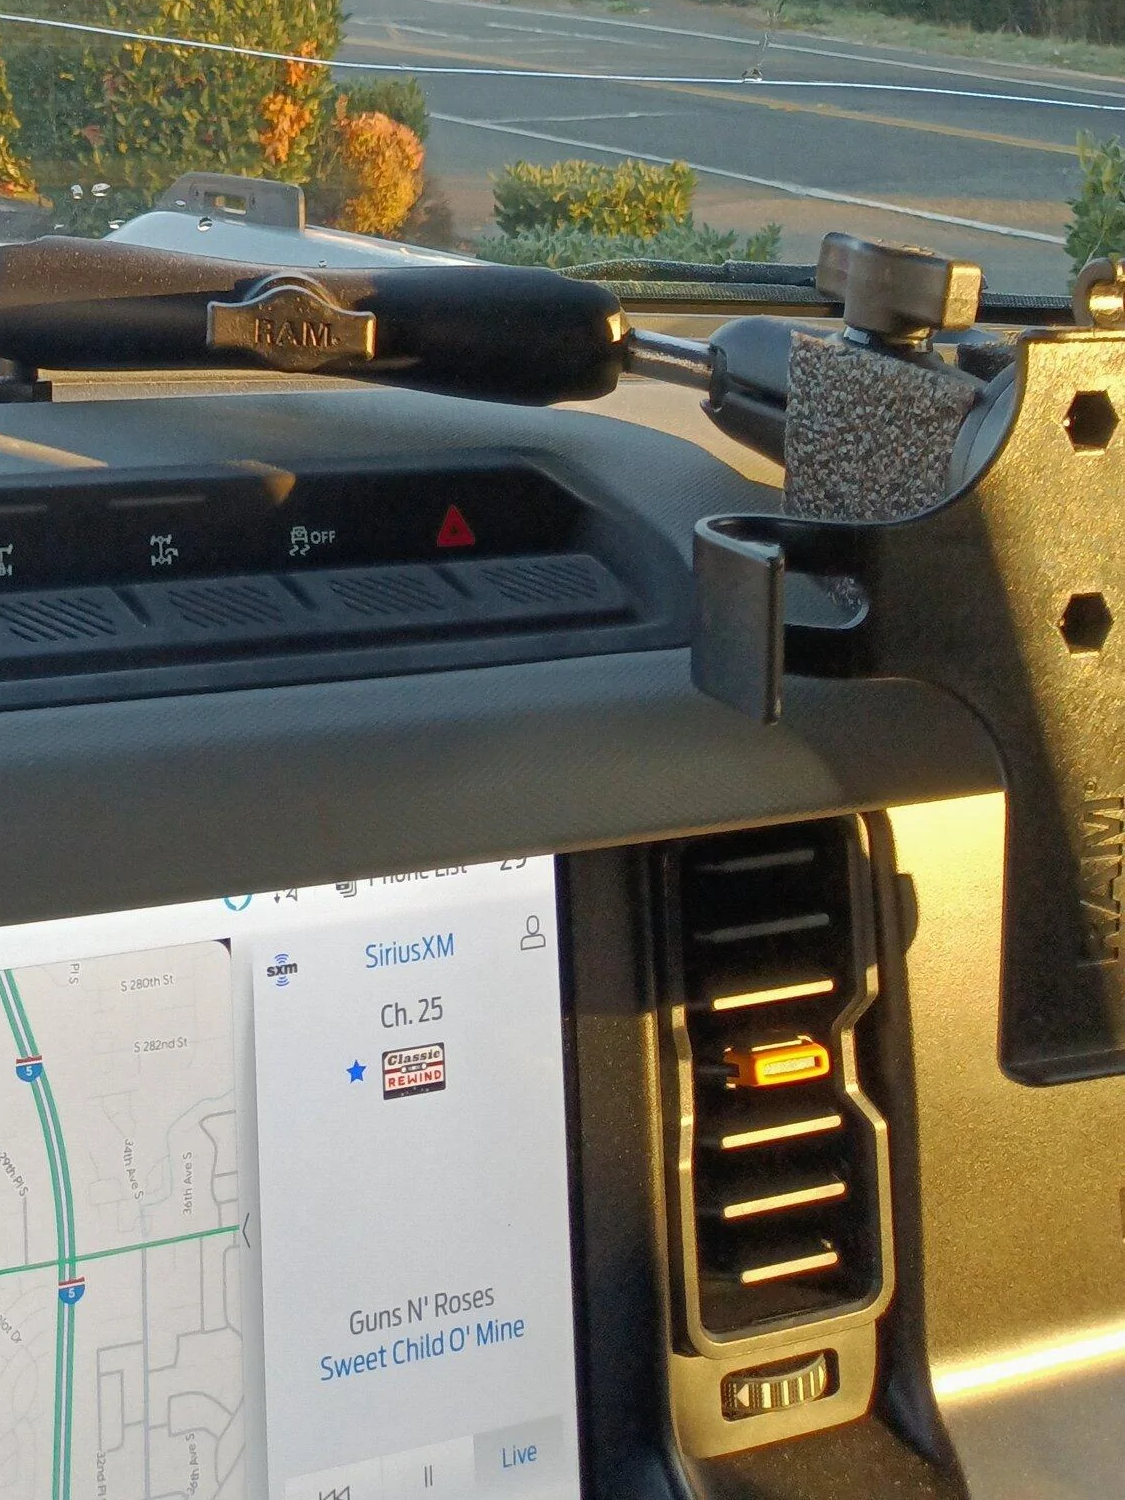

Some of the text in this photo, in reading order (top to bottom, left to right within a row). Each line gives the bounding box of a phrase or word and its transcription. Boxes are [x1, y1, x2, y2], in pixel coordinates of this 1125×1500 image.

[310, 530, 336, 544] OFF
[365, 933, 455, 969] SiriusXM
[121, 975, 174, 992] S 280th St
[381, 996, 443, 1029] Ch. 25
[134, 1036, 187, 1053] S 282nd St
[388, 1049, 441, 1066] Classic
[388, 1070, 441, 1087] REWIND
[183, 1159, 192, 1184] Ave
[18, 1186, 29, 1197] S
[126, 1168, 141, 1190] Ave
[134, 1190, 144, 1199] S
[349, 1288, 494, 1335] Guns N' Roses
[320, 1318, 525, 1381] Sweet Child O' Mine
[188, 1444, 198, 1467] Ave
[502, 1445, 537, 1468] Live
